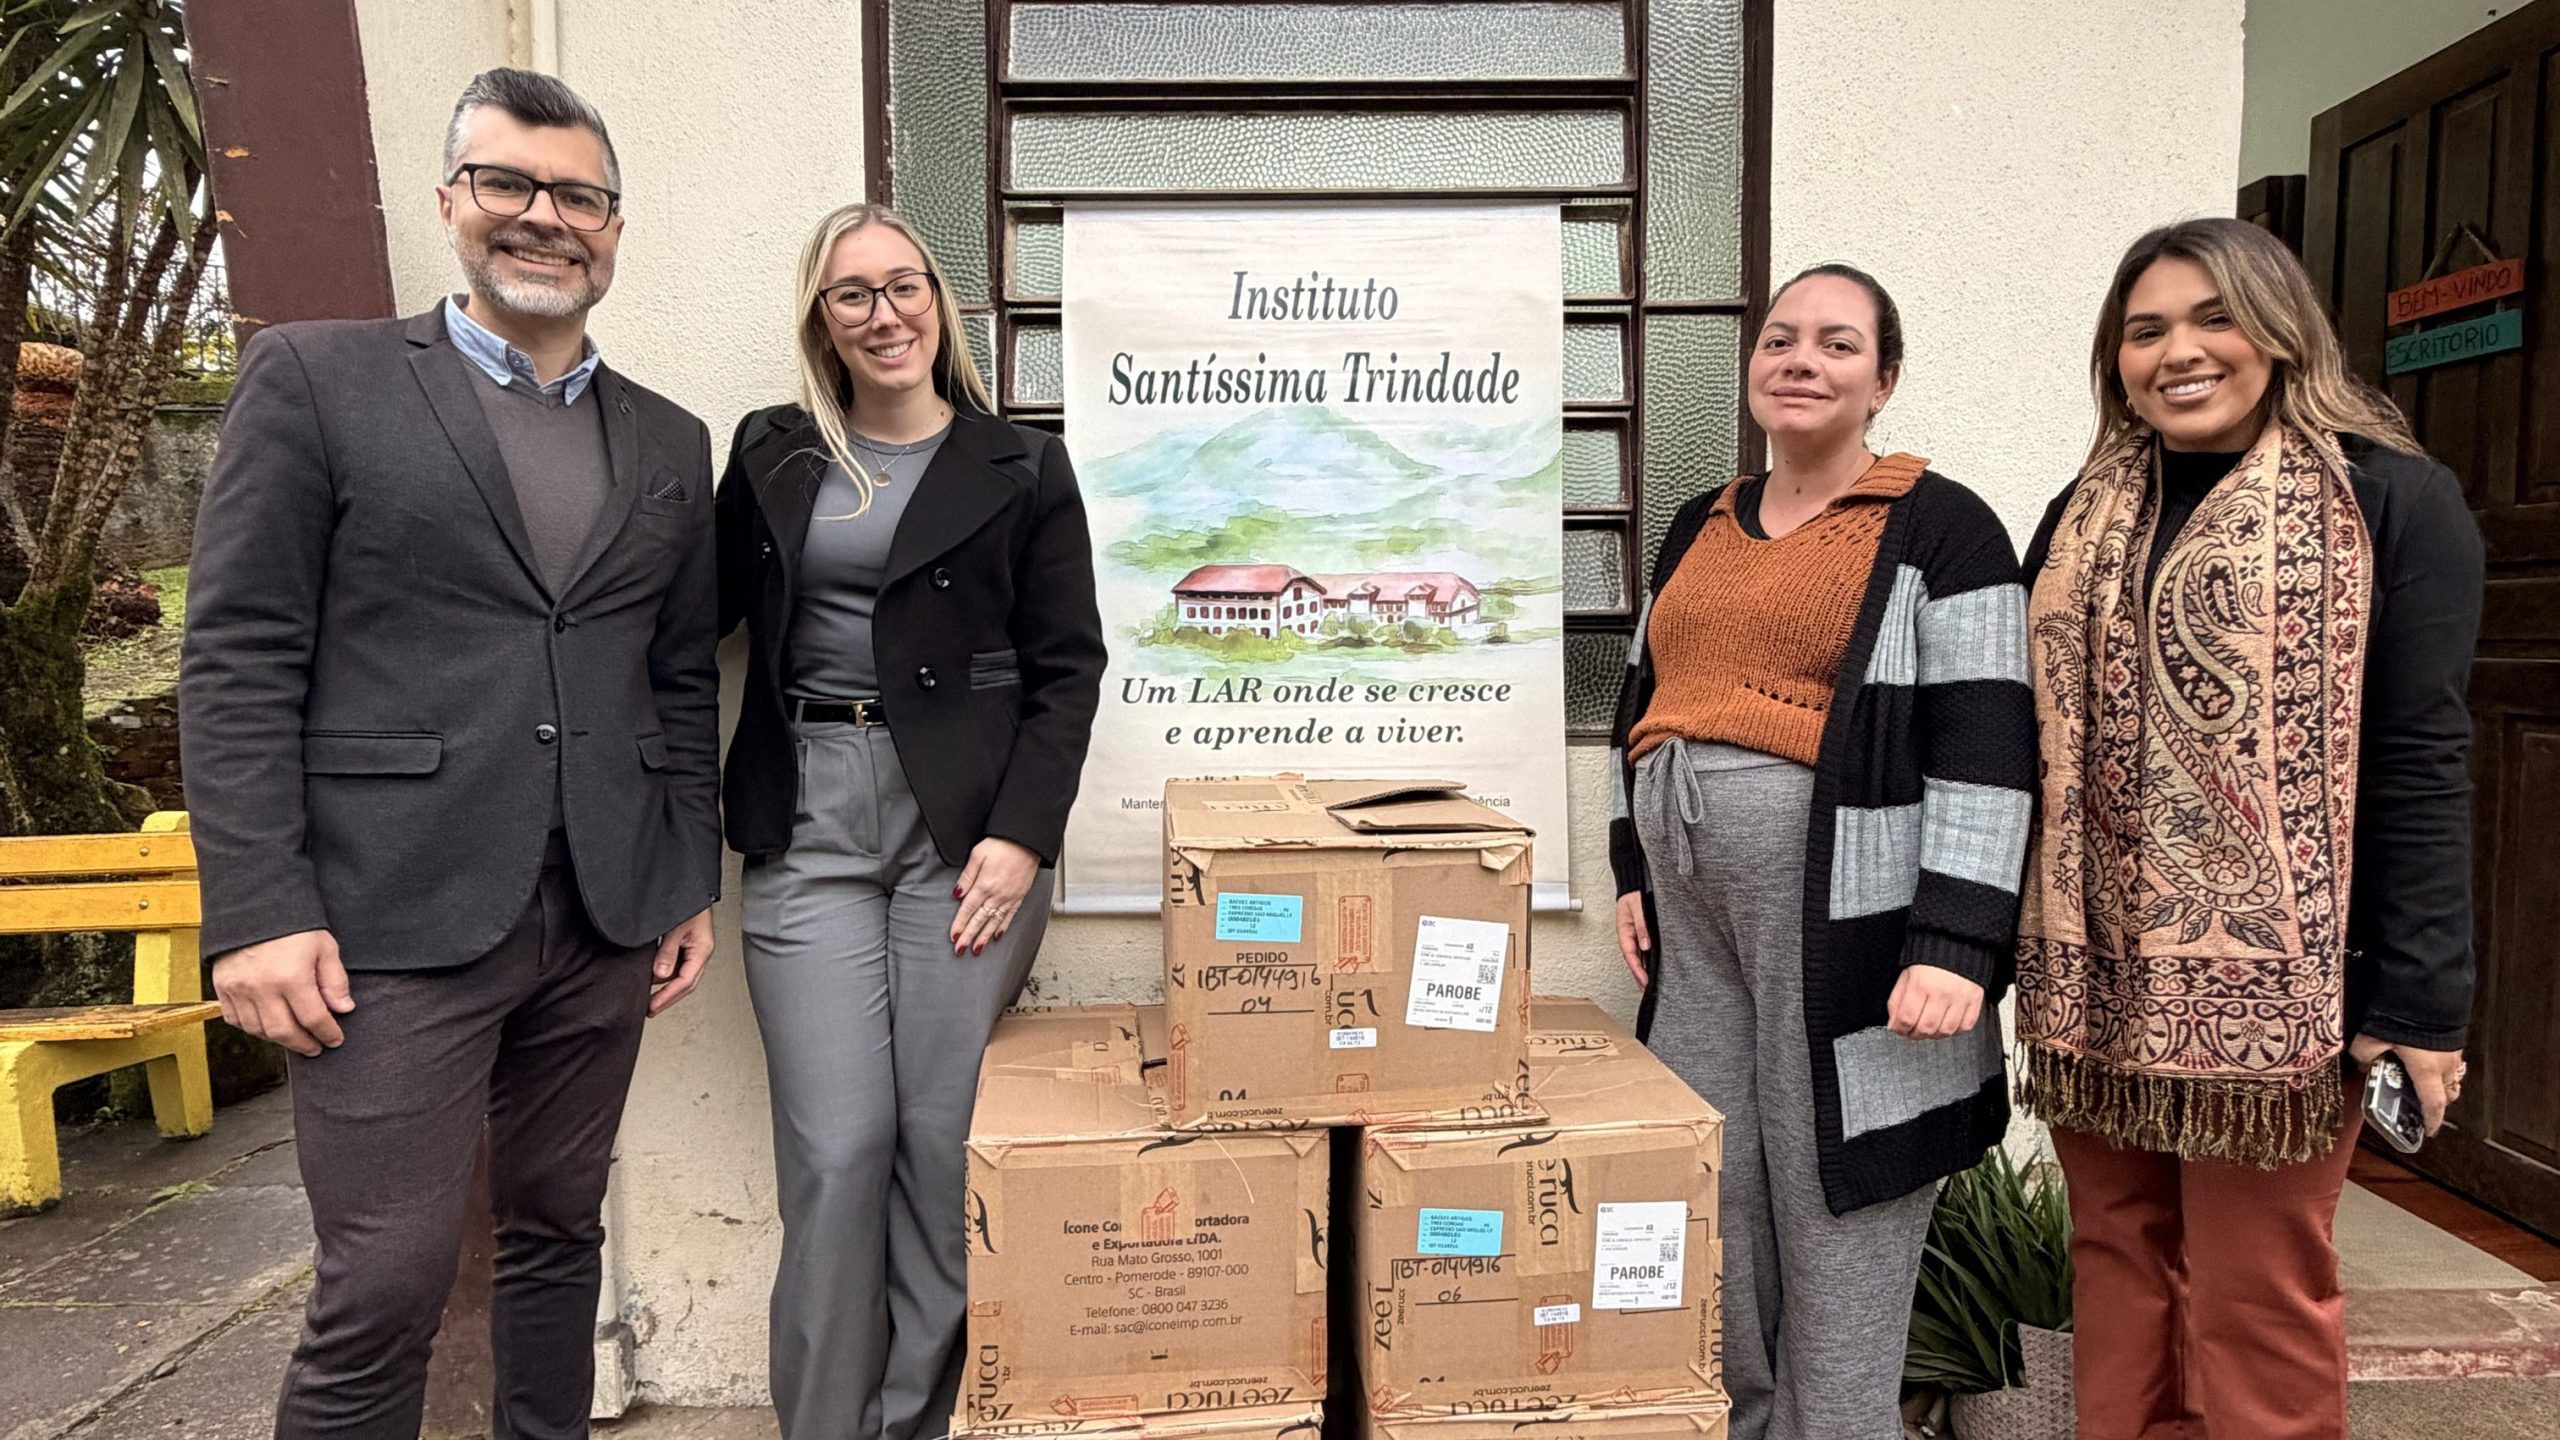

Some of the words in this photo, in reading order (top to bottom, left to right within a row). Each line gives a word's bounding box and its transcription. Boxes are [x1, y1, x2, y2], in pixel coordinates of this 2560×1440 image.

[1228, 271, 1399, 321] Instituto
[1108, 351, 1328, 405] Santíssima
[1341, 351, 1520, 405] Trindade
[1121, 676, 1177, 704] Um
[1186, 676, 1262, 703] LAR
[1273, 676, 1354, 703] onde
[1364, 681, 1398, 703] se
[1408, 681, 1512, 703] cresce
[1165, 723, 1182, 744] e
[1193, 717, 1334, 750] aprende
[1344, 724, 1365, 744] a
[1377, 718, 1465, 744] viver.
[1236, 952, 1288, 963] PEDIDO
[1426, 983, 1482, 1001] PAROBE
[1092, 1241, 1100, 1250] e
[1091, 1256, 1114, 1267] Rua
[1118, 1253, 1148, 1266] Mato
[1151, 1252, 1194, 1265] Grosso,
[1198, 1249, 1222, 1262] 1001
[1064, 1274, 1104, 1286] Centro
[1115, 1269, 1177, 1283] Pomerode
[1187, 1264, 1249, 1279] 89107-000
[1610, 1265, 1664, 1280] PAROBE
[1128, 1287, 1144, 1299] SC
[1155, 1285, 1186, 1297] Brasil
[1438, 1286, 1462, 1302] 06
[1085, 1306, 1139, 1318] Telefone:
[1142, 1303, 1173, 1316] 0800
[1176, 1301, 1197, 1313] 047
[1201, 1298, 1228, 1311] 3236
[1070, 1323, 1111, 1336] E-mail:
